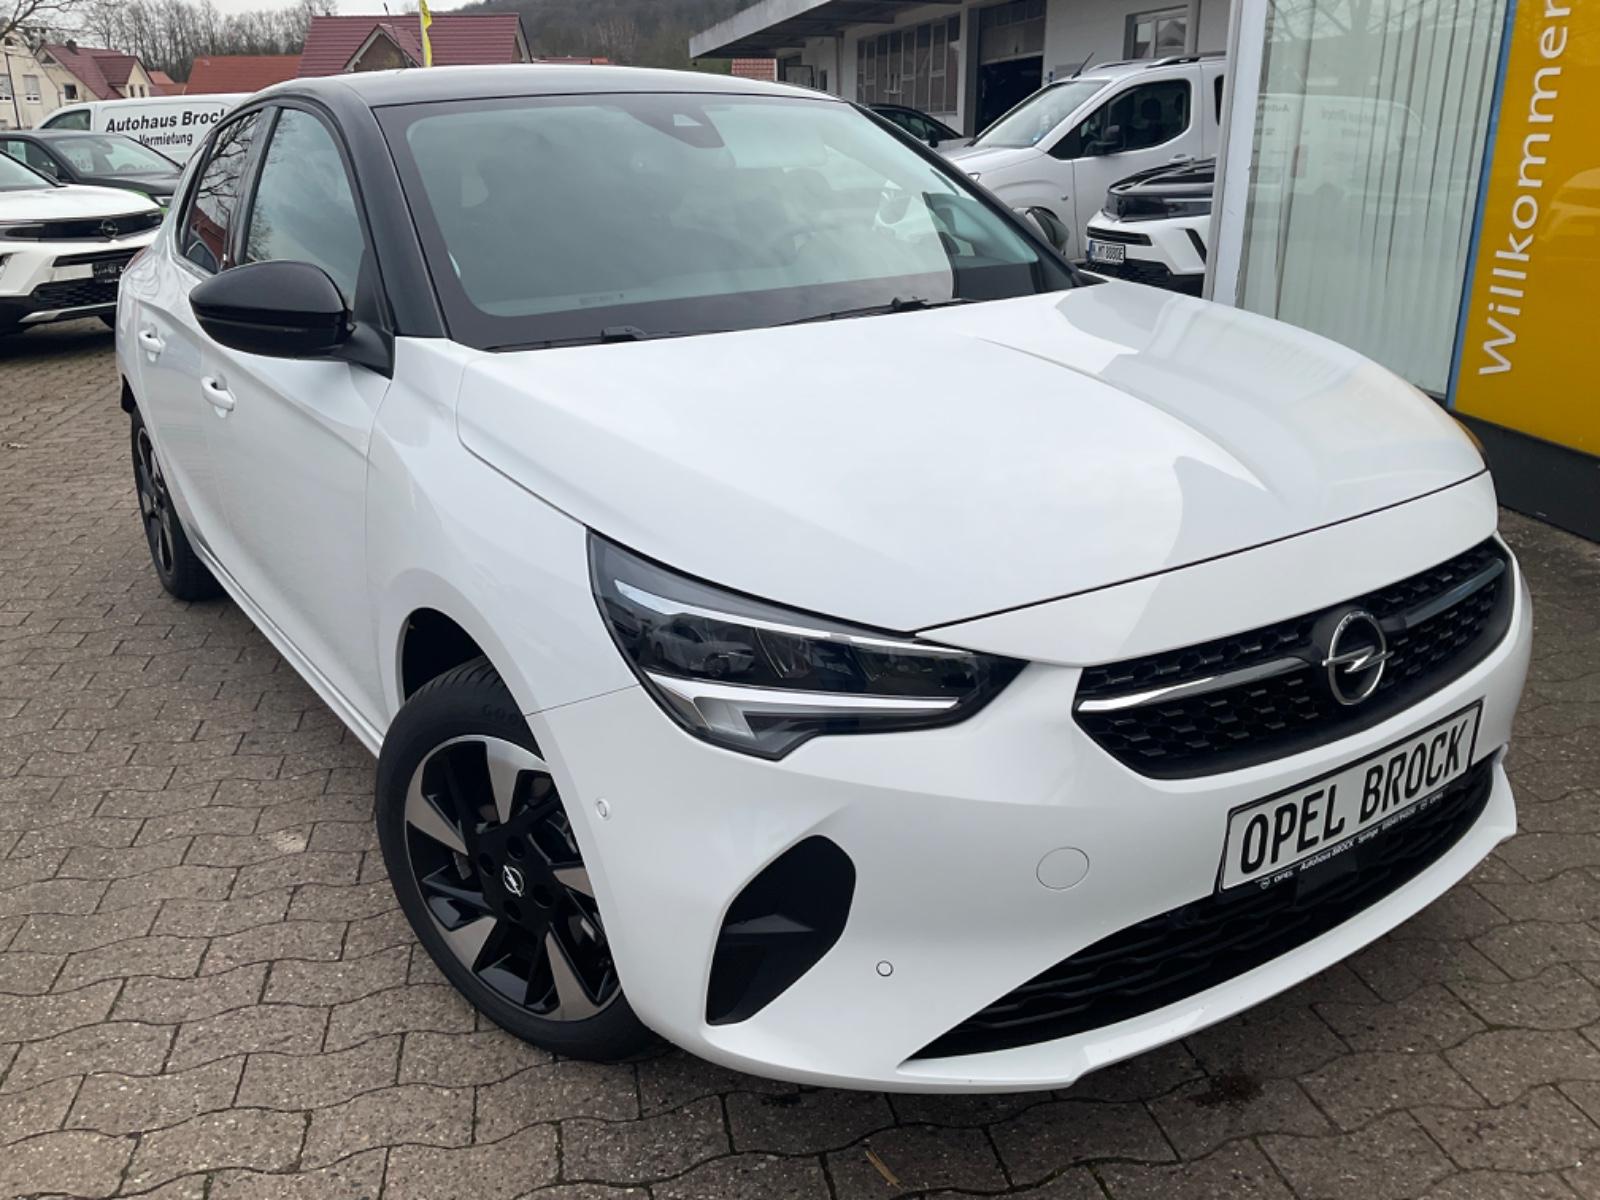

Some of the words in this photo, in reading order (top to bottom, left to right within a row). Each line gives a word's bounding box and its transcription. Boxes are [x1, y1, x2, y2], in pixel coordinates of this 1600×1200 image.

[105, 115, 177, 133] Autohaus
[139, 133, 193, 146] Vermietung
[1241, 784, 1345, 874] OPEL
[1359, 719, 1468, 824] BROCK
